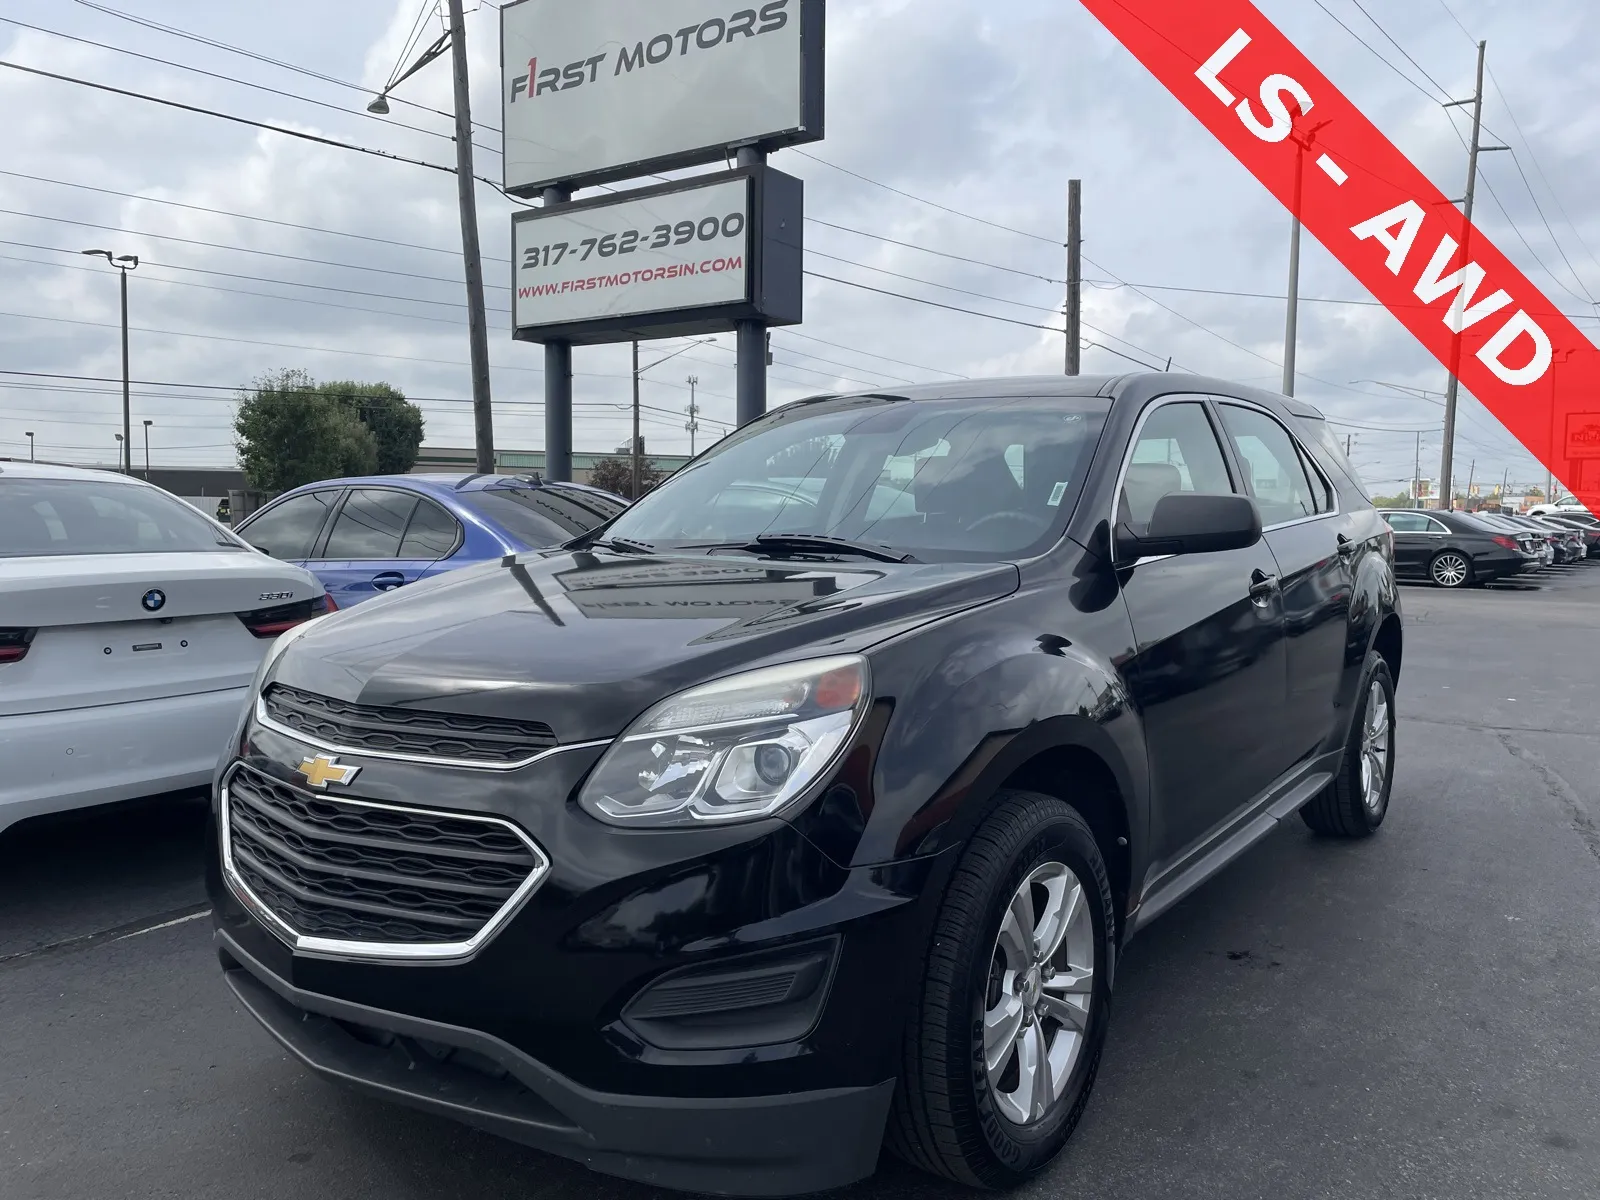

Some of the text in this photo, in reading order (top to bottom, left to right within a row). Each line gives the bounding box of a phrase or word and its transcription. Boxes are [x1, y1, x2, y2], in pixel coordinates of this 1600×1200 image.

[614, 0, 789, 76] MOTORS
[521, 213, 745, 270] 317-762-3900
[518, 256, 742, 298] WWW.FIRSTMOTORSIN.COM
